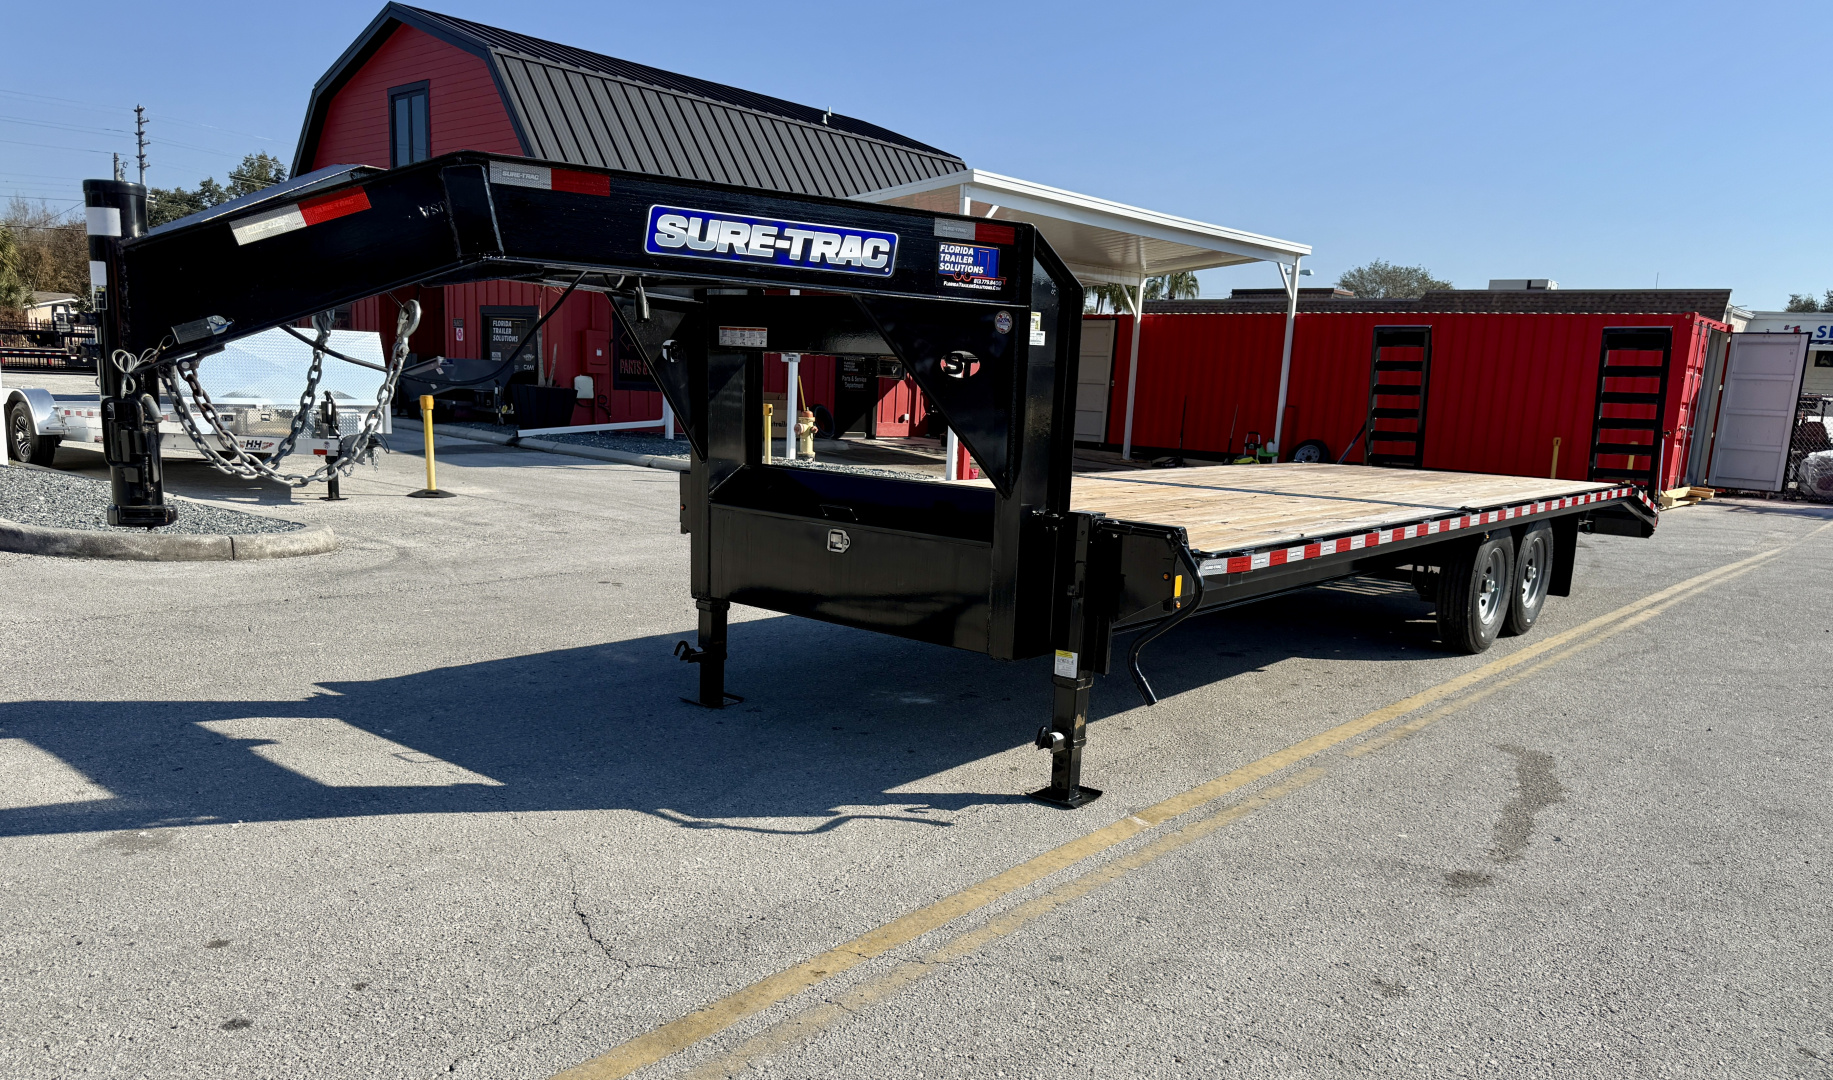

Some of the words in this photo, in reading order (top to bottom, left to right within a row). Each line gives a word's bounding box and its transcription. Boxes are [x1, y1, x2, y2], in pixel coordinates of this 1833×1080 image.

[502, 170, 540, 181] SURE-TRAC
[654, 213, 891, 269] SURE-TRAC
[940, 244, 974, 256] FLORIDA
[940, 253, 974, 264] TRAILER
[939, 263, 984, 274] SOLUTIONS
[619, 358, 642, 375] PARTS
